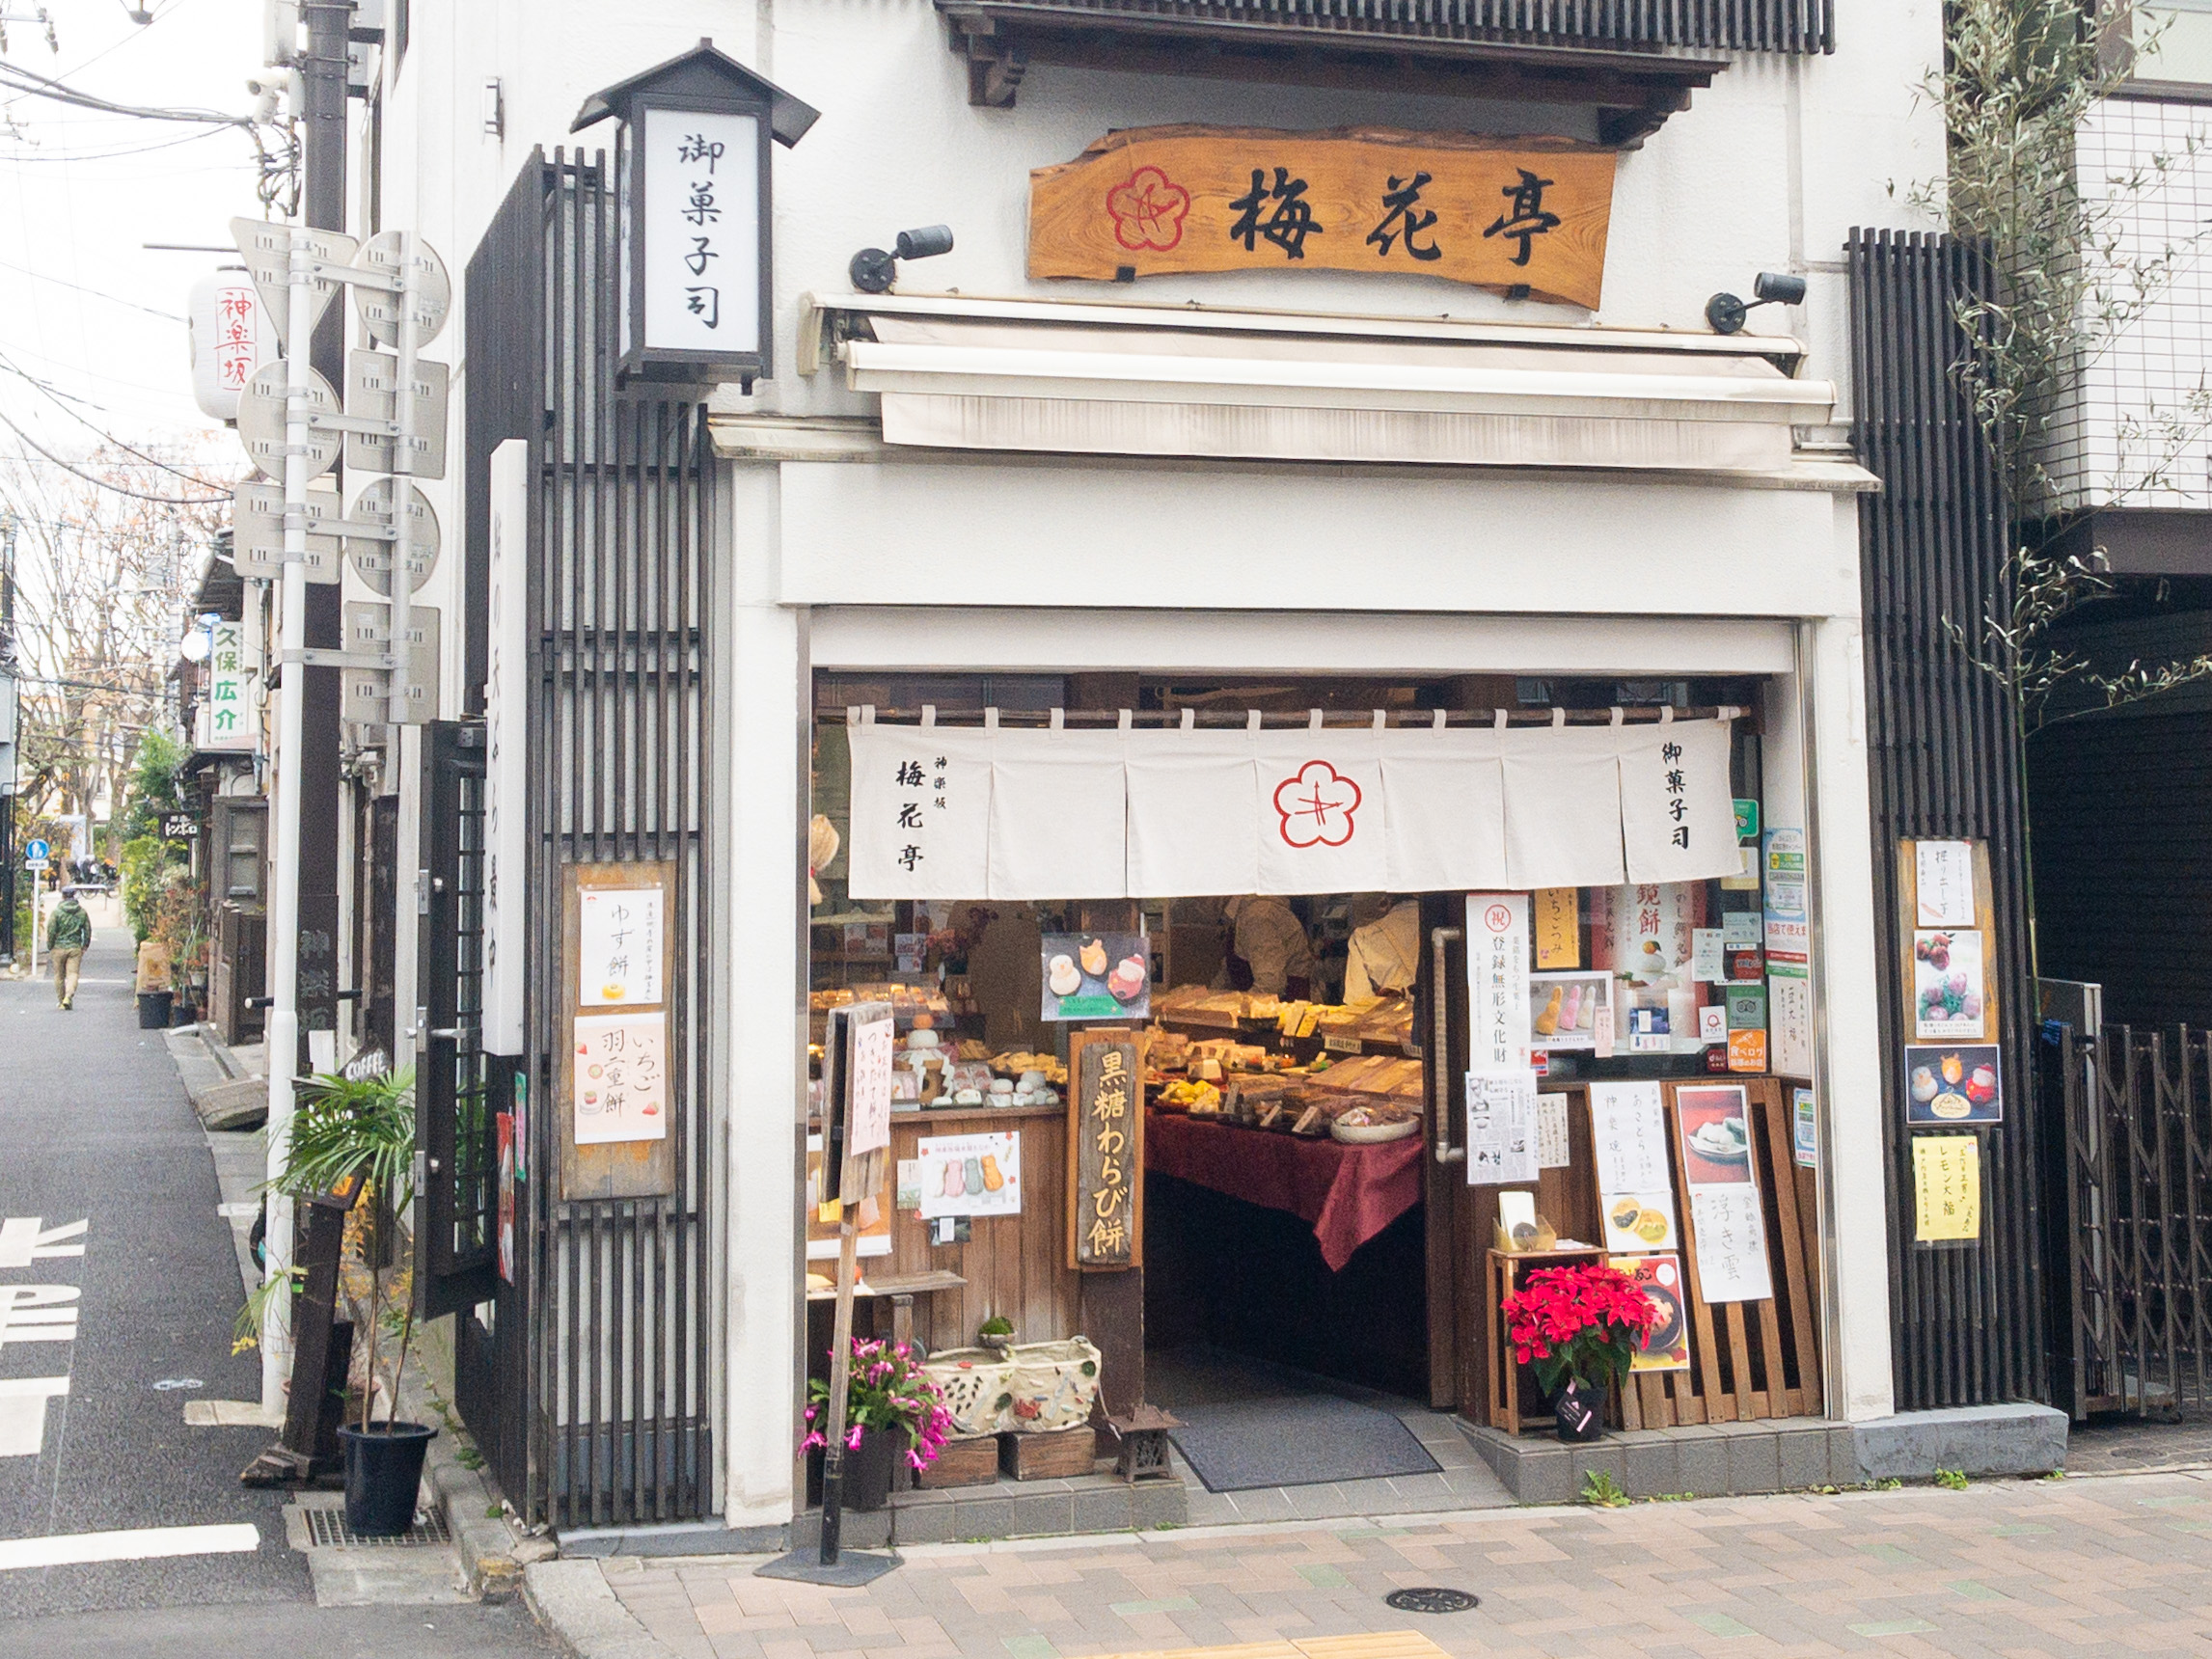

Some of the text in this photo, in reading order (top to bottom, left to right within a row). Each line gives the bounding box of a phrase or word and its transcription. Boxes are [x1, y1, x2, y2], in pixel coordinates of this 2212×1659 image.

[677, 133, 725, 330] 御菓子司
[1229, 167, 1562, 267] 梅花亭
[214, 291, 255, 386] 神楽坂
[214, 627, 237, 731] 久保広介
[895, 760, 926, 873] 梅花亭
[1661, 741, 1689, 850] 御菓子司
[1491, 911, 1505, 926] 祝
[1636, 884, 1661, 937] 鏡餅
[1491, 936, 1507, 1063] 登録無形文化財
[602, 1028, 626, 1118] 羽二重餅
[633, 1036, 660, 1092] いちご
[1087, 1050, 1128, 1256] 黒糖わらび餅
[1940, 1146, 1954, 1215] レモン大福
[1711, 1194, 1740, 1281] 浮き雲
